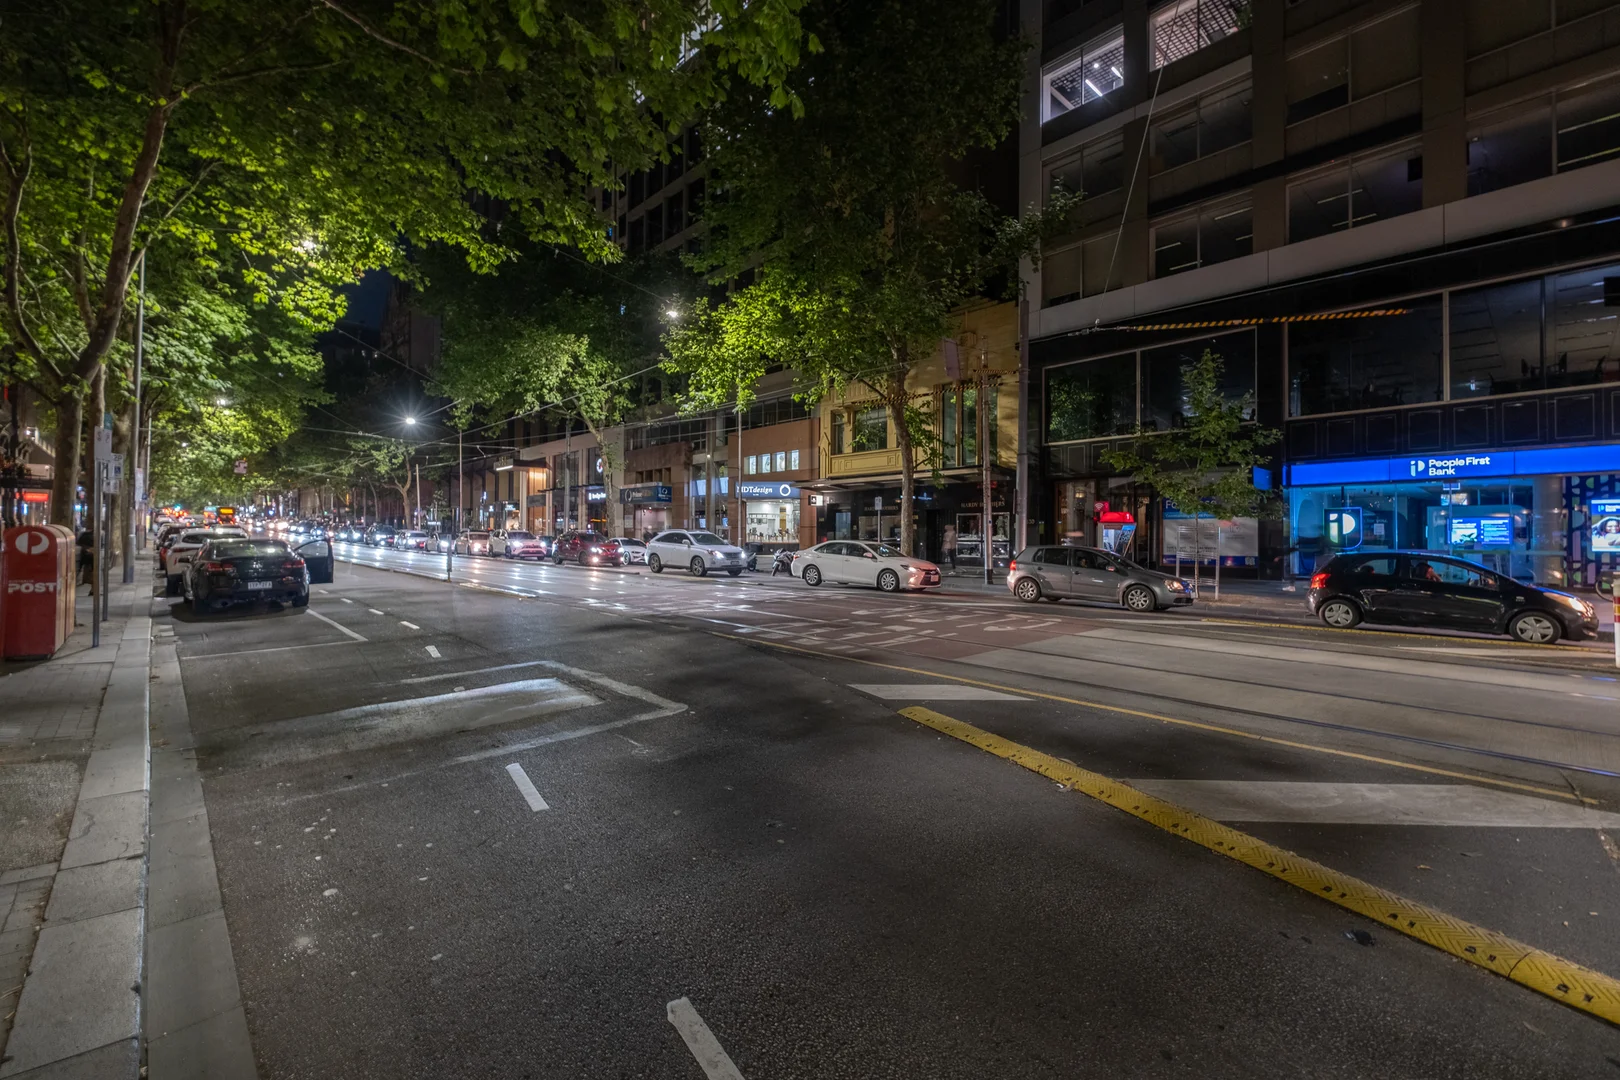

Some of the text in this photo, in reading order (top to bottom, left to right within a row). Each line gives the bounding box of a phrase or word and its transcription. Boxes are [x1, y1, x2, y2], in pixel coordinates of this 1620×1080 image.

[1428, 456, 1491, 469] People First
[1428, 467, 1456, 476] Bank
[7, 582, 57, 594] POST
